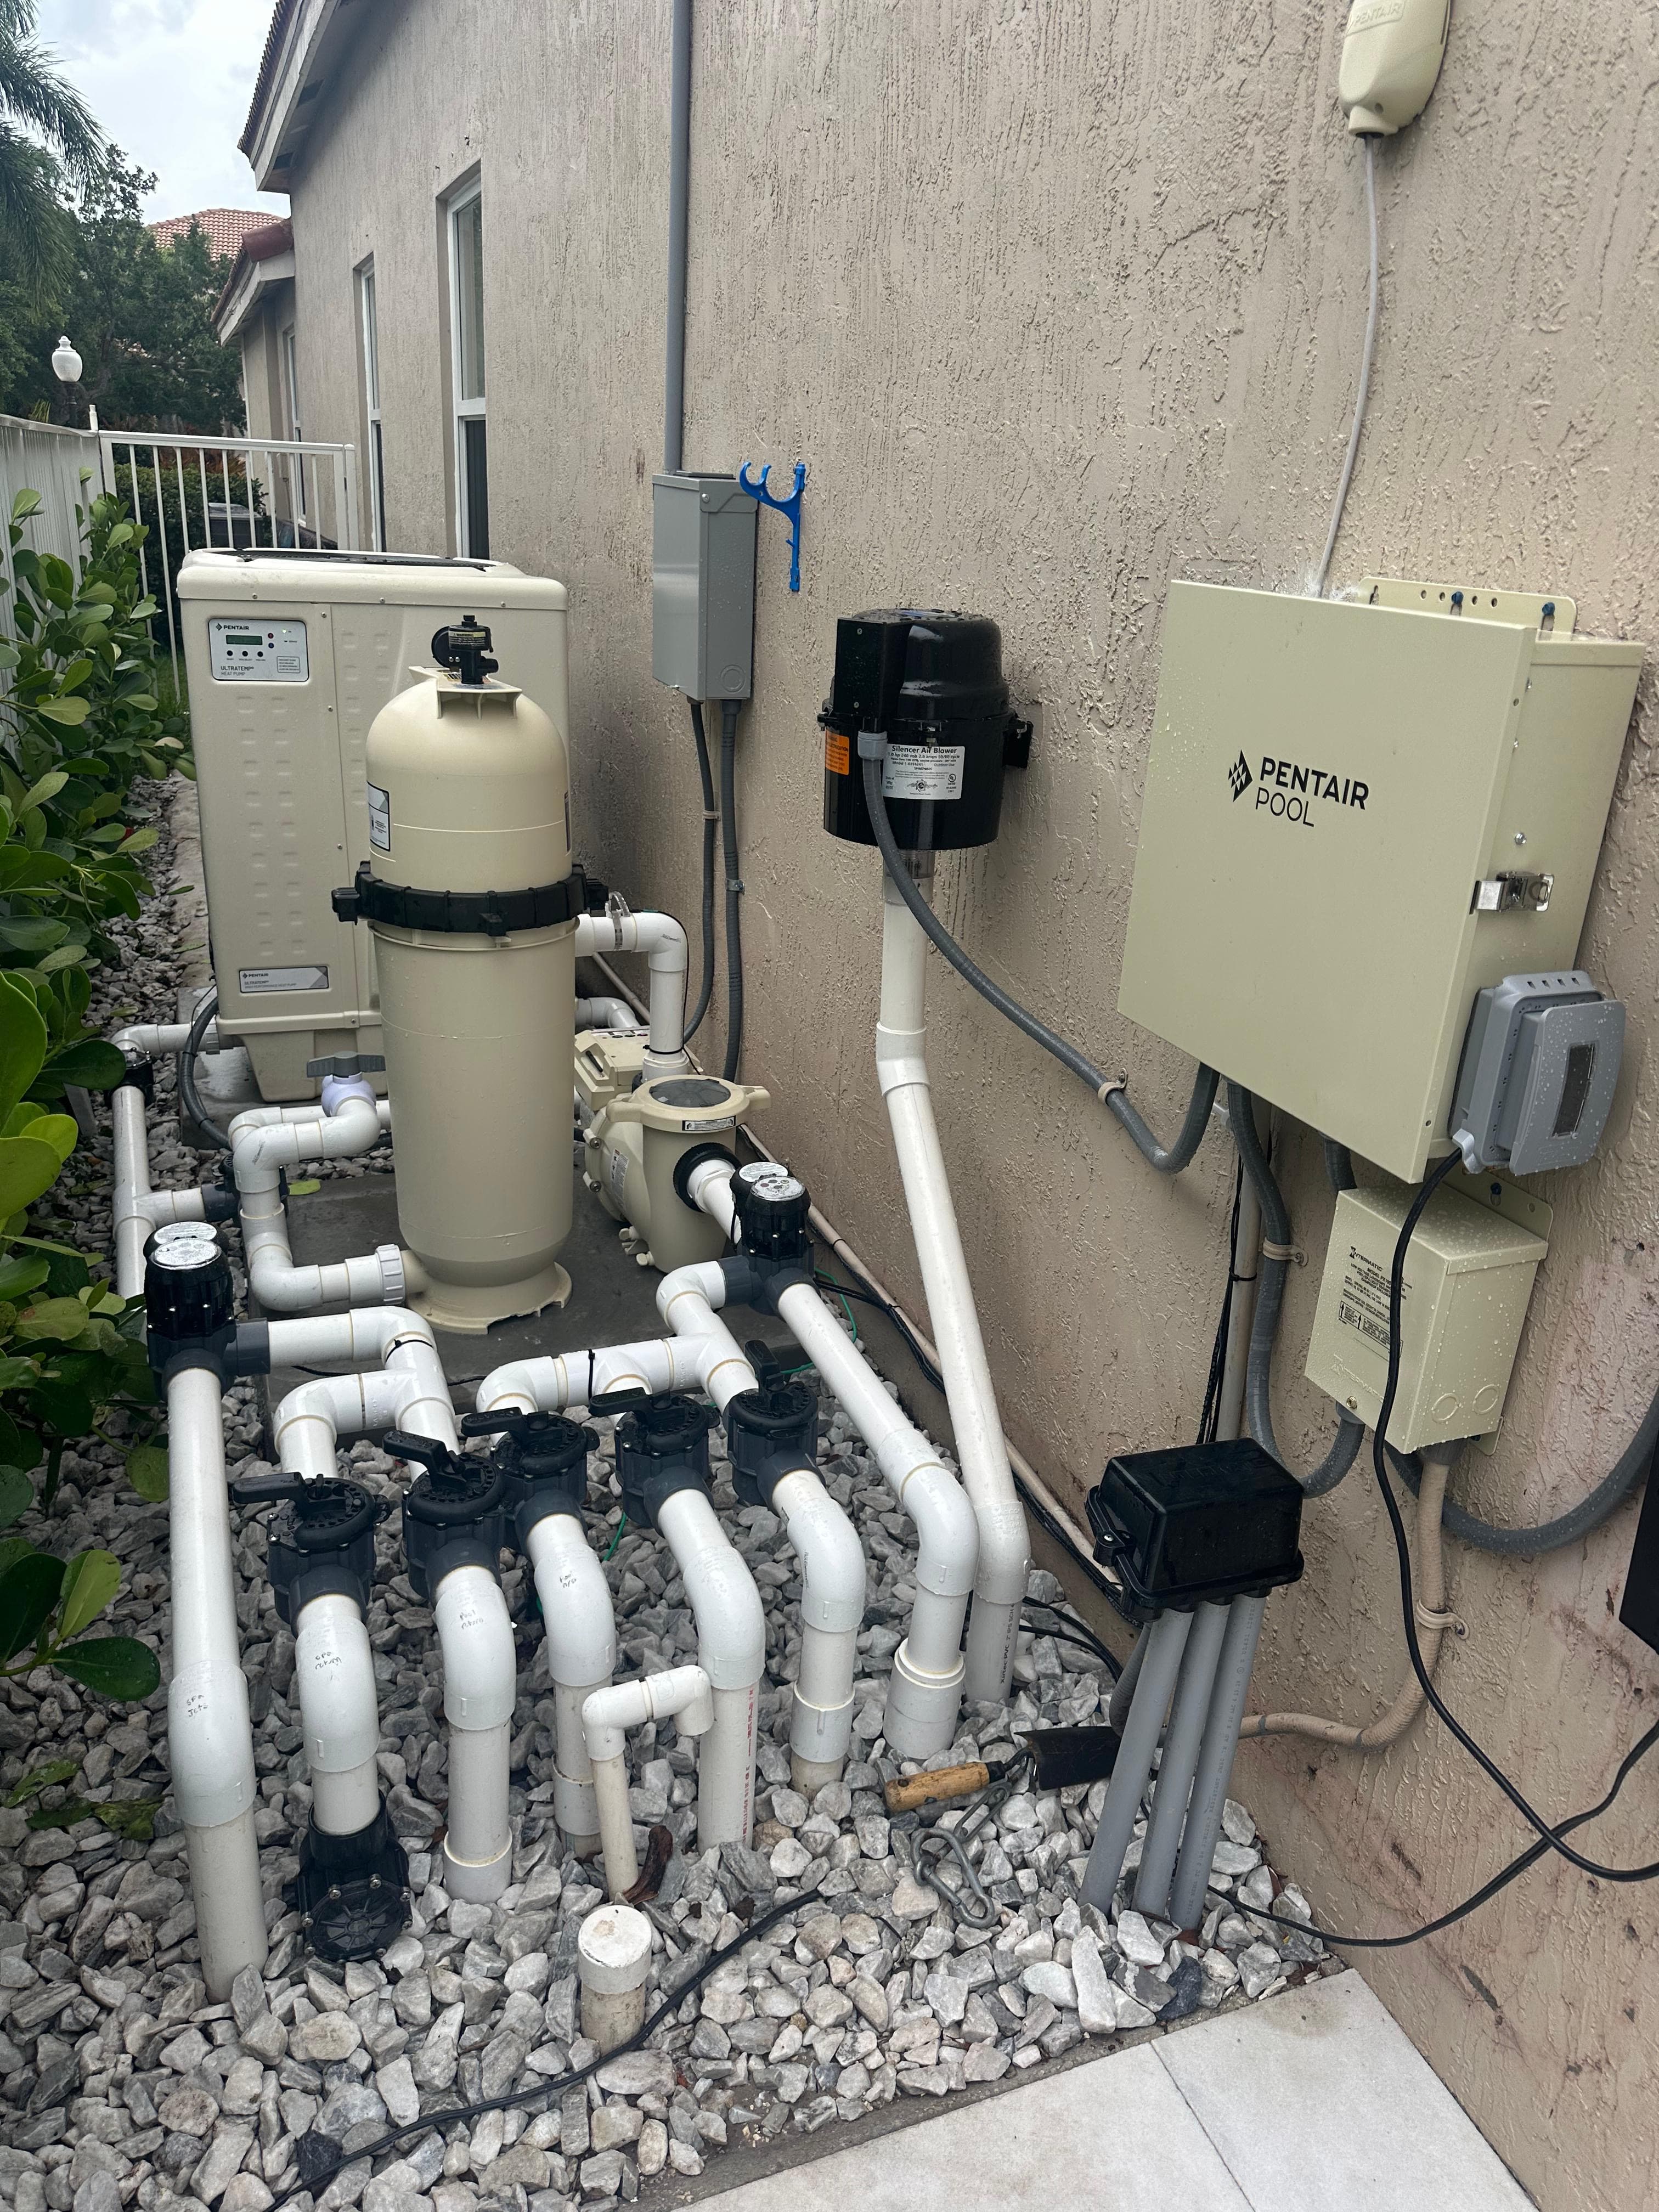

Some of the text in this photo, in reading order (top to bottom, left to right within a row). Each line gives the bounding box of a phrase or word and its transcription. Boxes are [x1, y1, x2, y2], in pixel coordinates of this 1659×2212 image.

[1260, 757, 1369, 810] PENTAIR
[1255, 787, 1314, 827] POOL
[1350, 1246, 1383, 1272] INTERMATIC
